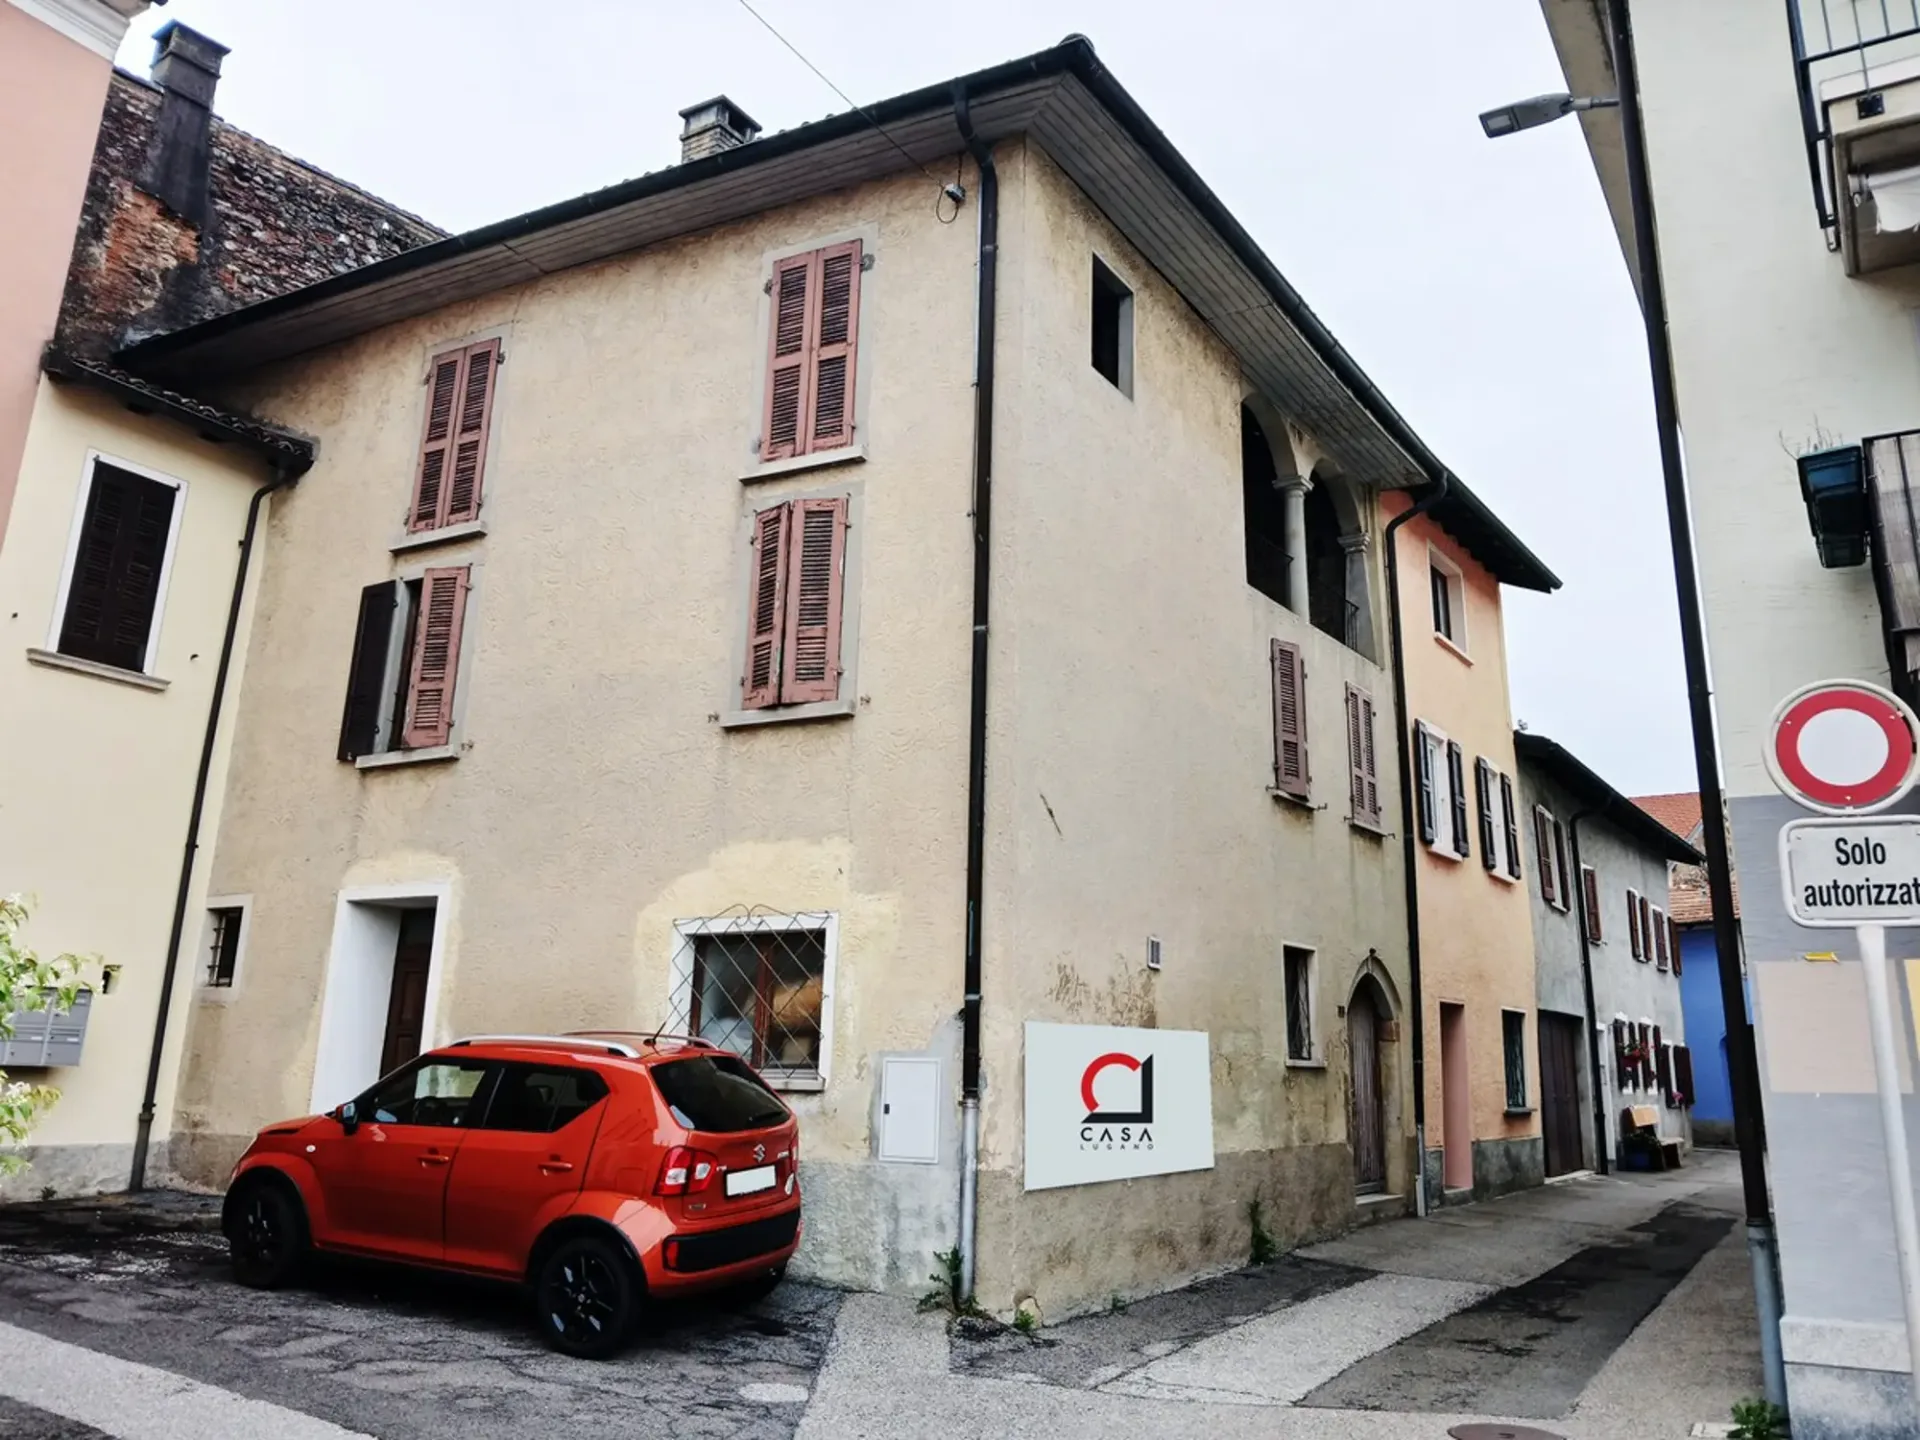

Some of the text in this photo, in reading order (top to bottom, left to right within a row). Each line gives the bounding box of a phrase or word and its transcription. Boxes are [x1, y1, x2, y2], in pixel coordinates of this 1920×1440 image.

[1835, 836, 1887, 866] Solo
[1804, 876, 1920, 907] autorizzat
[1080, 1127, 1153, 1142] CASA
[1080, 1143, 1154, 1151] LUGANO
